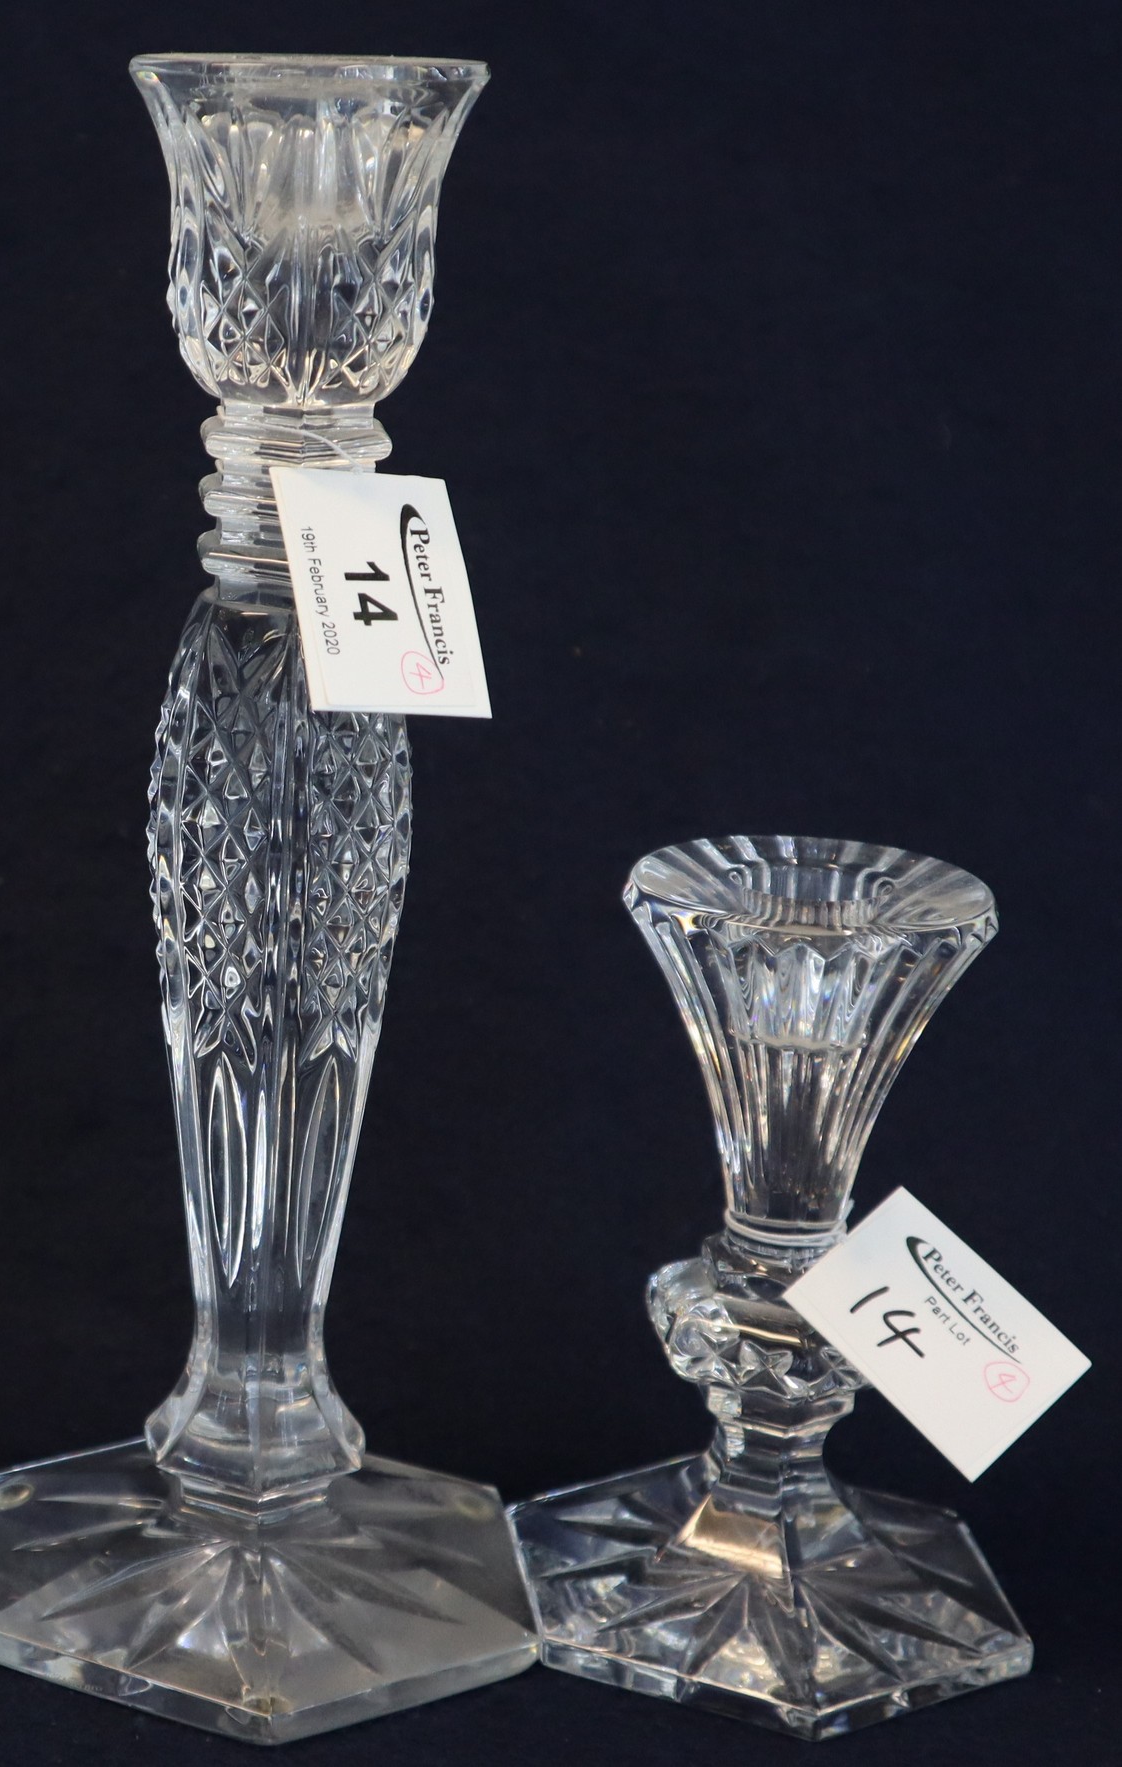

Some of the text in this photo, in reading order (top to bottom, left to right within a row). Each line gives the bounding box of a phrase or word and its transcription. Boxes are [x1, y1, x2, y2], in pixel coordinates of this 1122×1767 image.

[300, 526, 340, 655] 19th February 2020
[344, 561, 398, 627] 14
[409, 528, 454, 665] Peter Francis
[849, 1286, 925, 1359] 14
[922, 1247, 1019, 1354] Peter Francis
[924, 1296, 972, 1346] Part Lot
